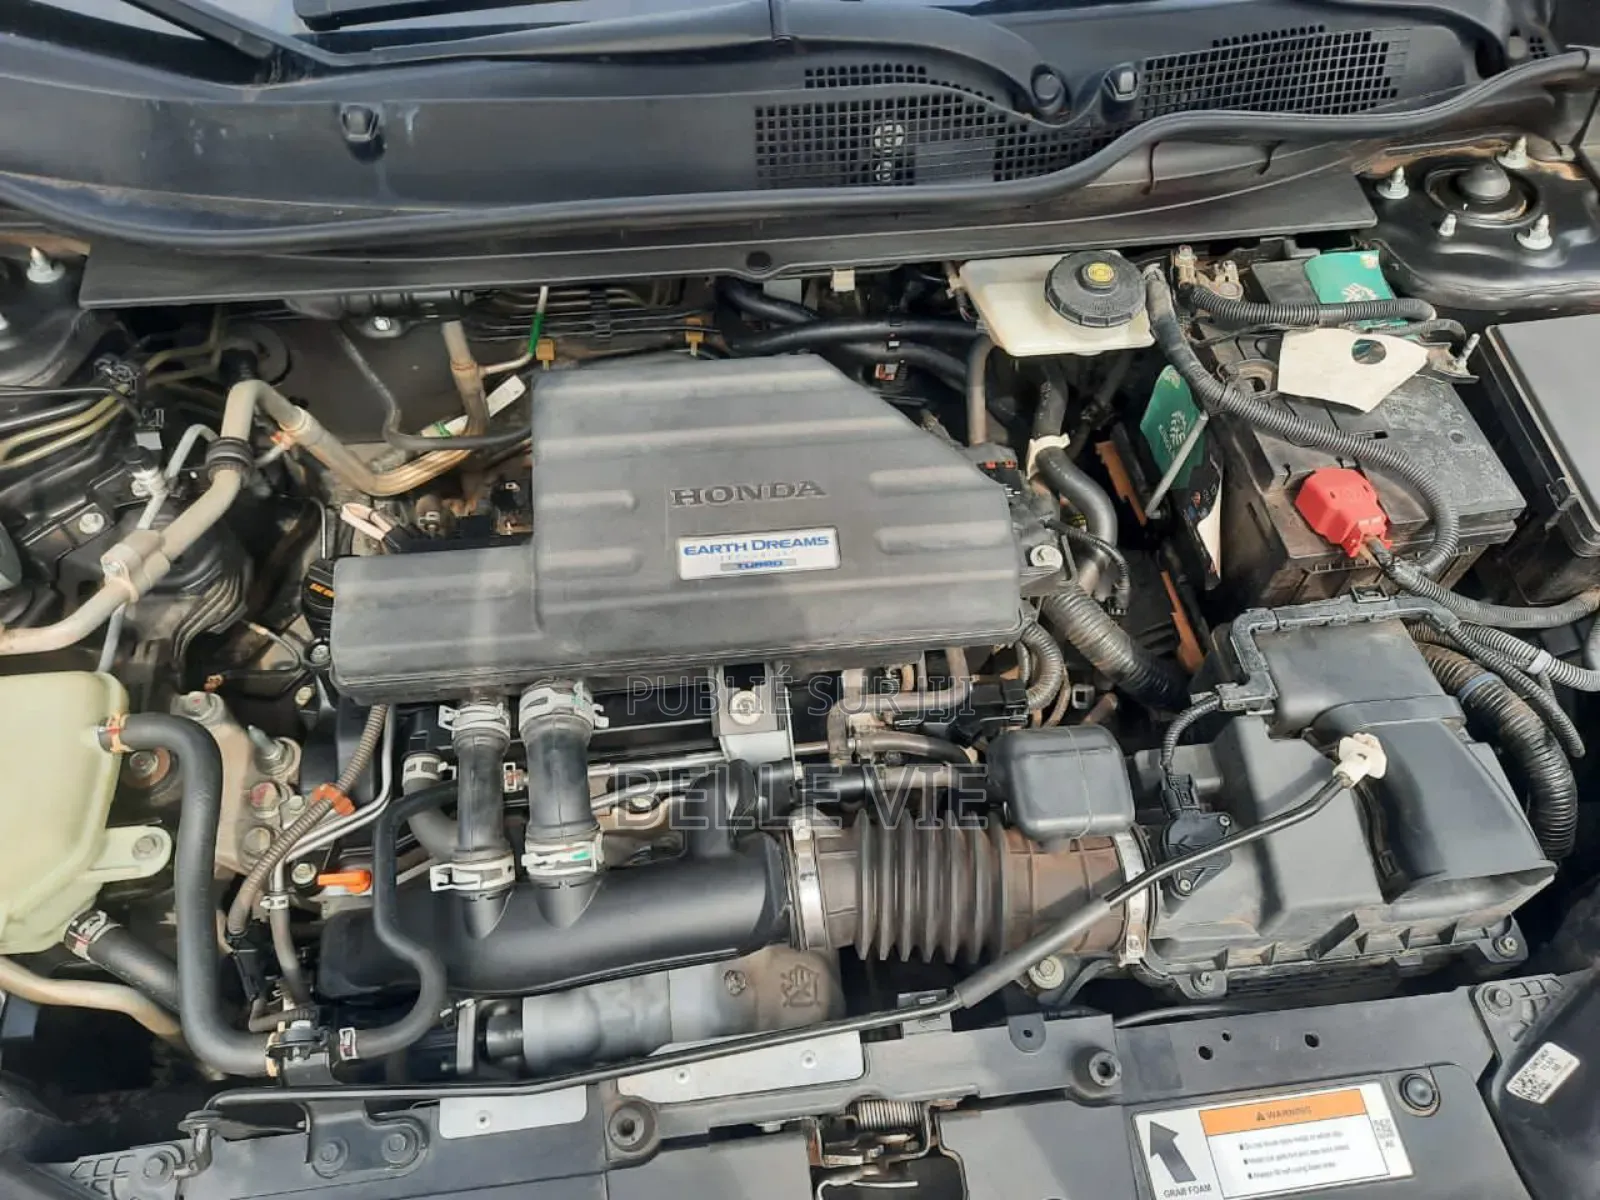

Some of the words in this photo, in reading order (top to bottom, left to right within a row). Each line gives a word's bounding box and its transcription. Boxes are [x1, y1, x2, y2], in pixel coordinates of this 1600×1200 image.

[670, 479, 827, 507] HONDA
[683, 541, 748, 556] EARTH
[751, 535, 830, 552] DREAMS
[736, 558, 784, 571] TURBO
[1267, 1105, 1313, 1121] WARNING
